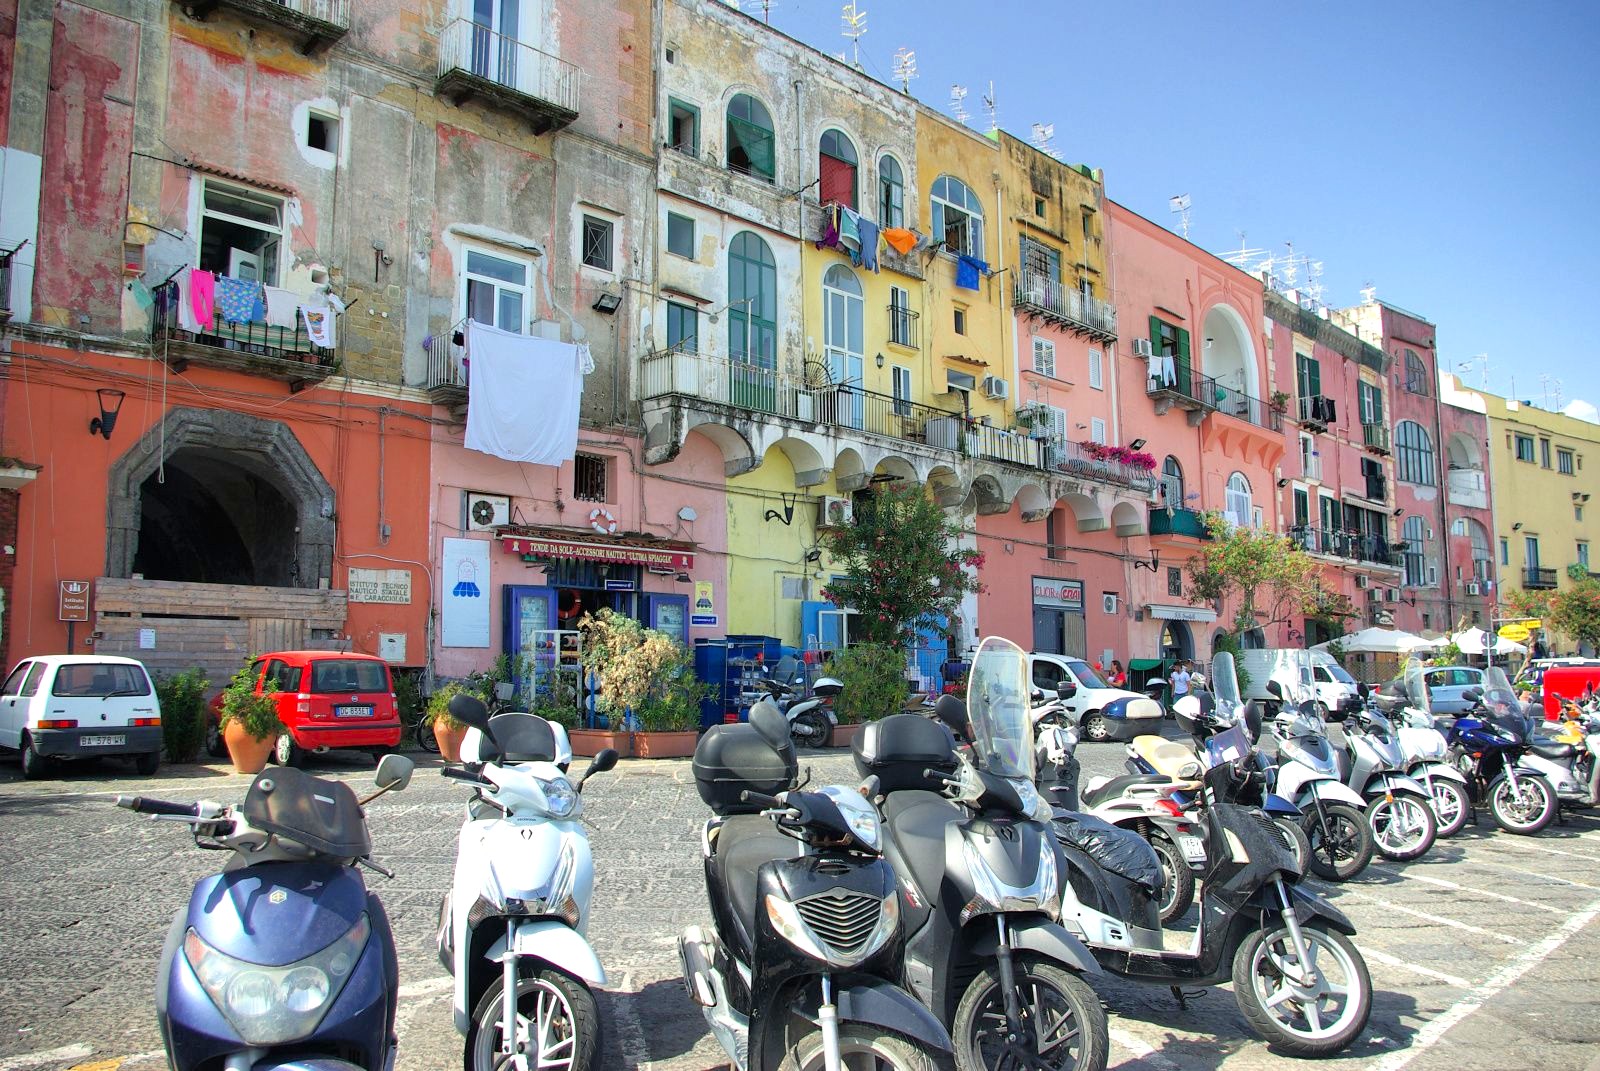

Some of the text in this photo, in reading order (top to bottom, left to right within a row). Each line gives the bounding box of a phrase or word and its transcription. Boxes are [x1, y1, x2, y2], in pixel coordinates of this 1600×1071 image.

[530, 543, 549, 552] TENDE
[550, 545, 558, 553] DA
[606, 550, 627, 560] NAUTICI
[350, 581, 408, 590] ISTITUTO TECNICO
